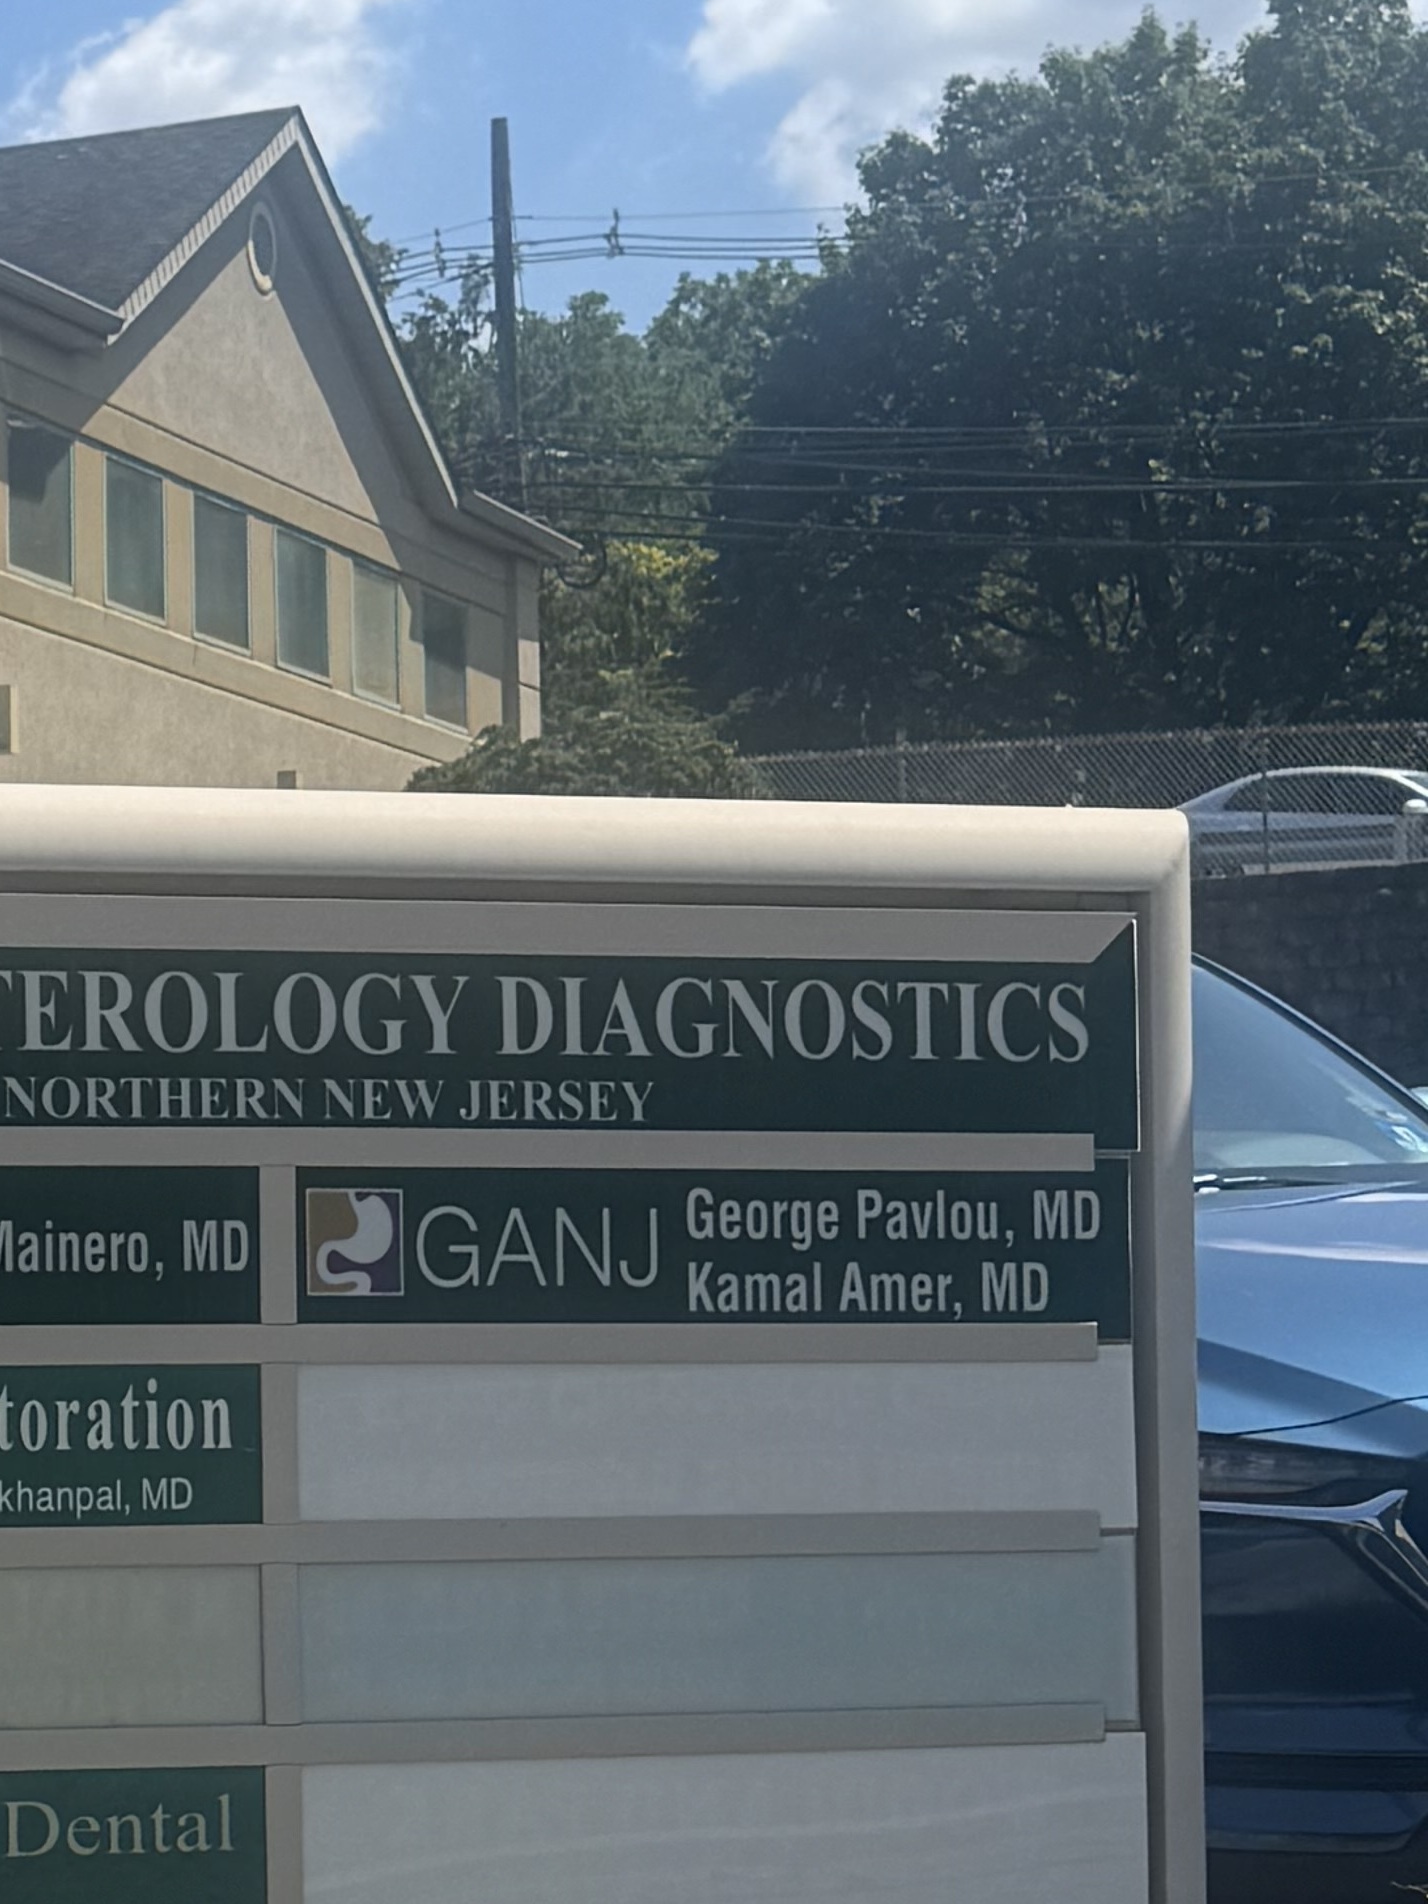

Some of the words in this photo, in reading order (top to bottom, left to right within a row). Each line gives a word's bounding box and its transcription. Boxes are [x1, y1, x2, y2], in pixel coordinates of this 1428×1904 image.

[495, 976, 1088, 1062] DIAGNOSTICS
[4, 1077, 304, 1119] NORTHERN
[324, 1079, 444, 1119] NEW
[460, 1080, 653, 1121] JERSEY
[184, 1220, 248, 1271] MD
[417, 1206, 657, 1288] GANJ
[687, 1188, 838, 1250] George
[858, 1190, 1013, 1247] Pavlou,
[1034, 1190, 1100, 1239] MD
[689, 1262, 821, 1312] Kamal
[839, 1263, 964, 1320] Amer,
[982, 1262, 1048, 1312] MD
[143, 1477, 192, 1510] MD
[4, 1793, 234, 1857] Dental
